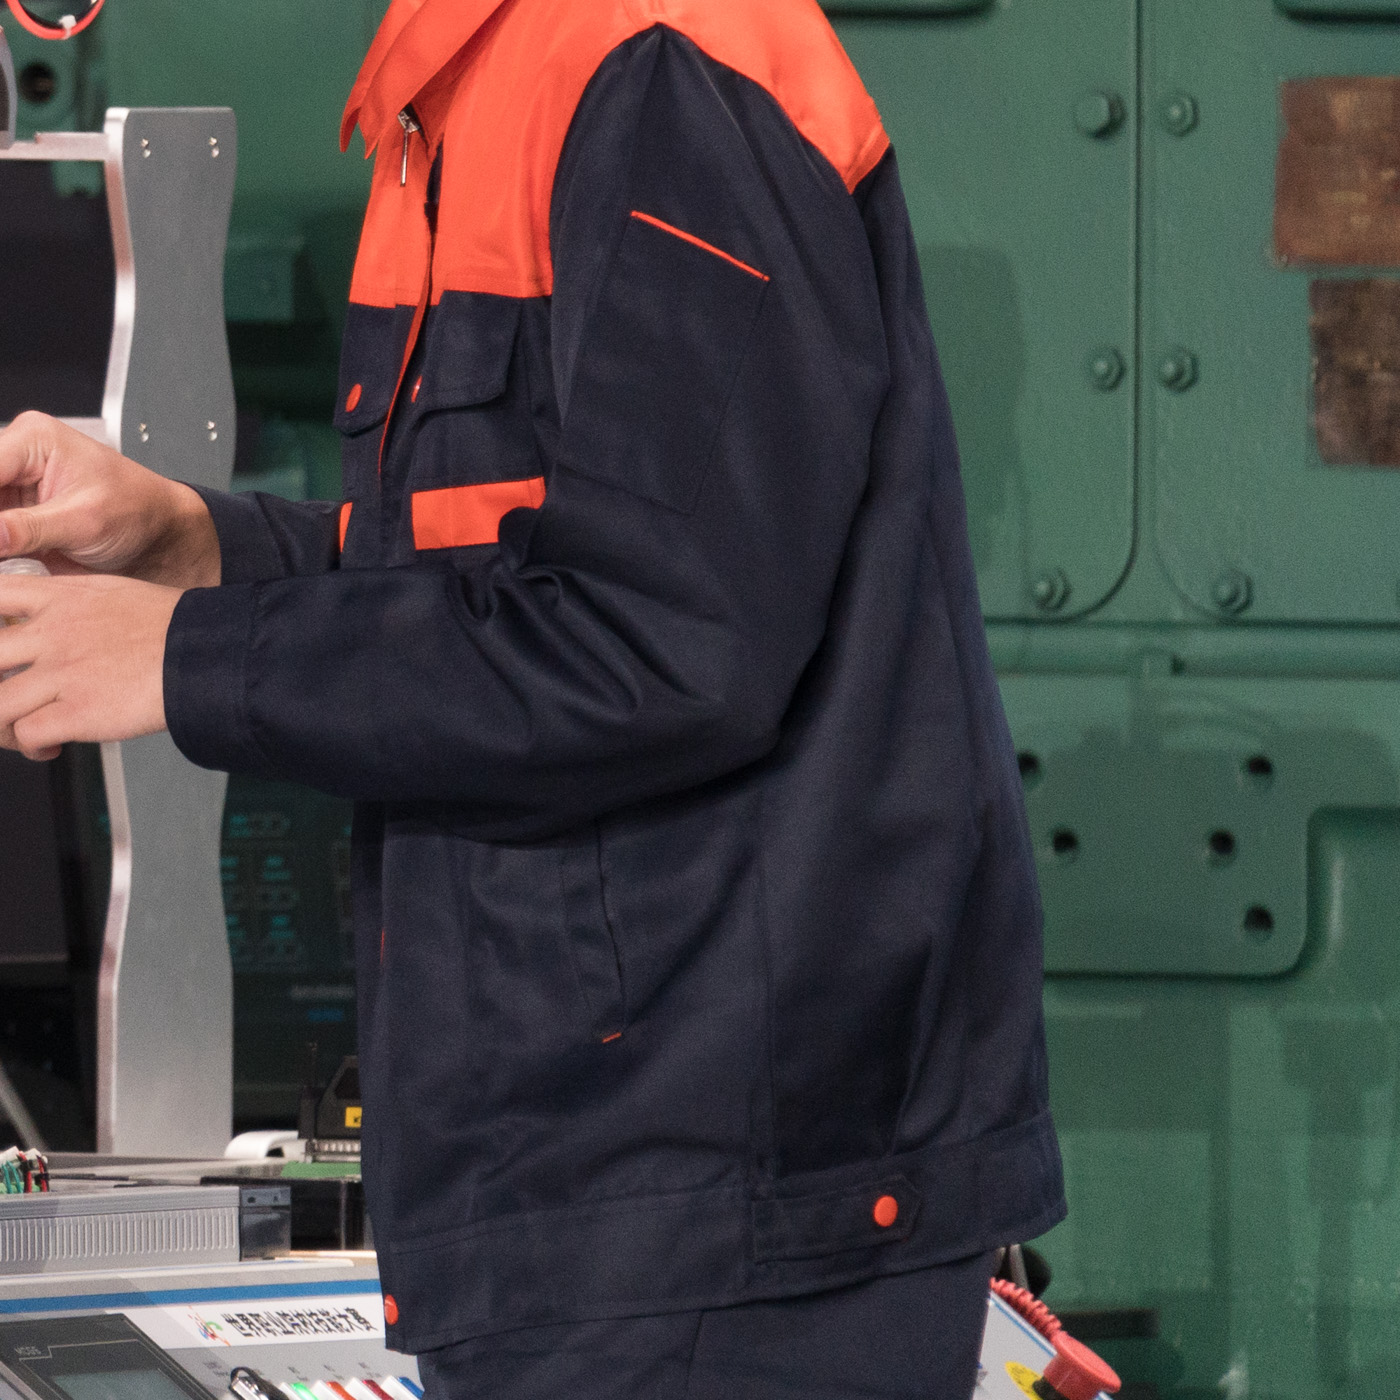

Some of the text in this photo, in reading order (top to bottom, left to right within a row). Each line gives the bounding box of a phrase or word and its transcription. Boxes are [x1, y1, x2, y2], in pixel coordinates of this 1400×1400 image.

[220, 1306, 378, 1338] 世界职业院校技能大赛
